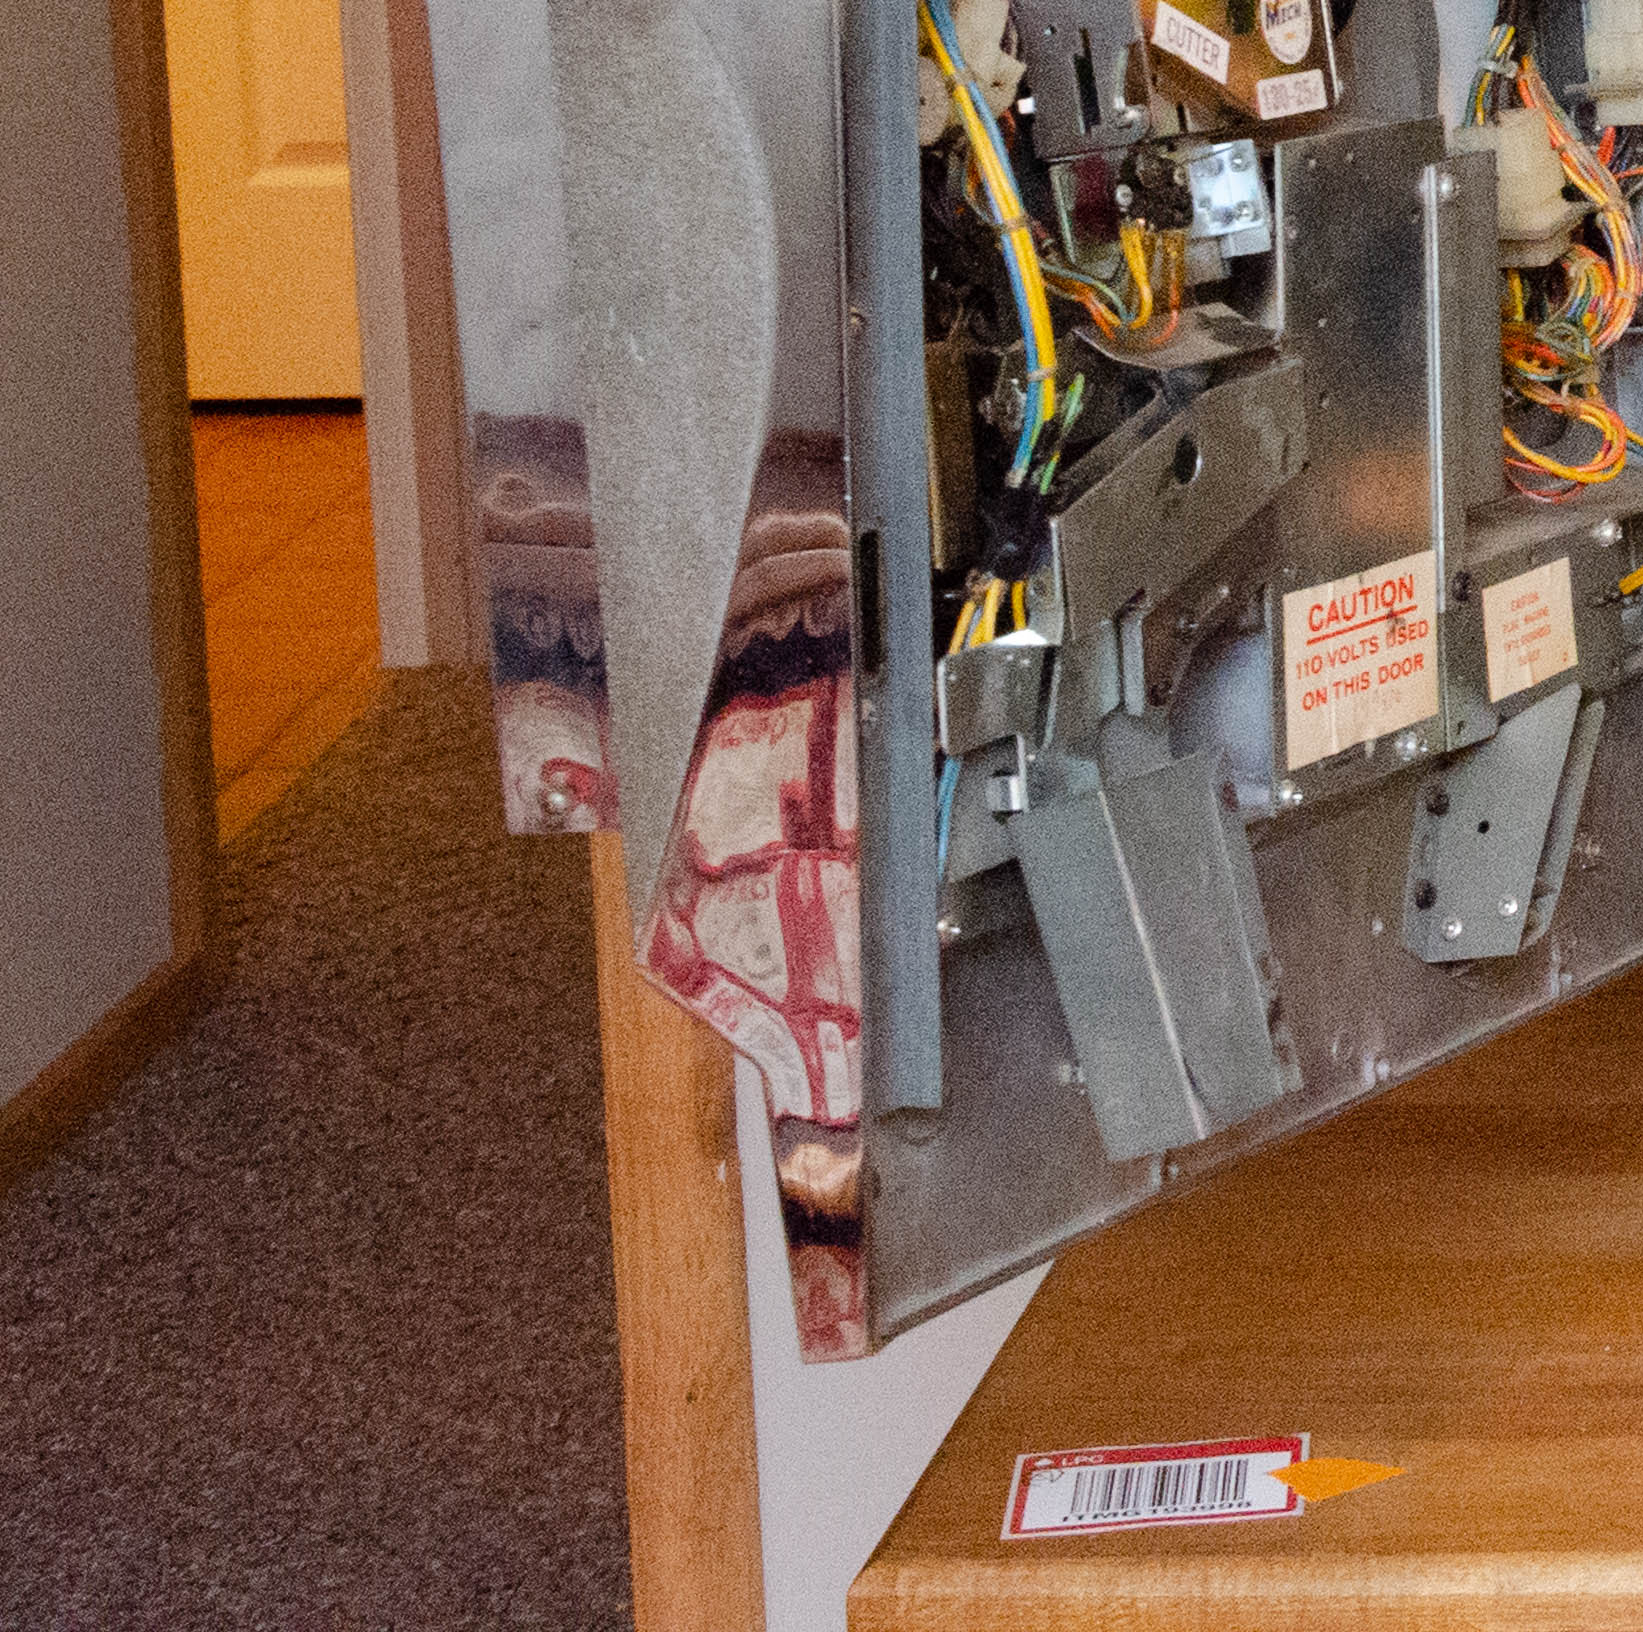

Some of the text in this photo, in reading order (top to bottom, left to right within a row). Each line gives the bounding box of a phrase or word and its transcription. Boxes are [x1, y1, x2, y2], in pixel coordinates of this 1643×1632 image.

[1166, 16, 1221, 70] CUTTER
[1307, 574, 1416, 633] CAUTION
[1296, 618, 1430, 681] 110 VOLTS USED
[1301, 652, 1425, 712] ON THIS DOOR
